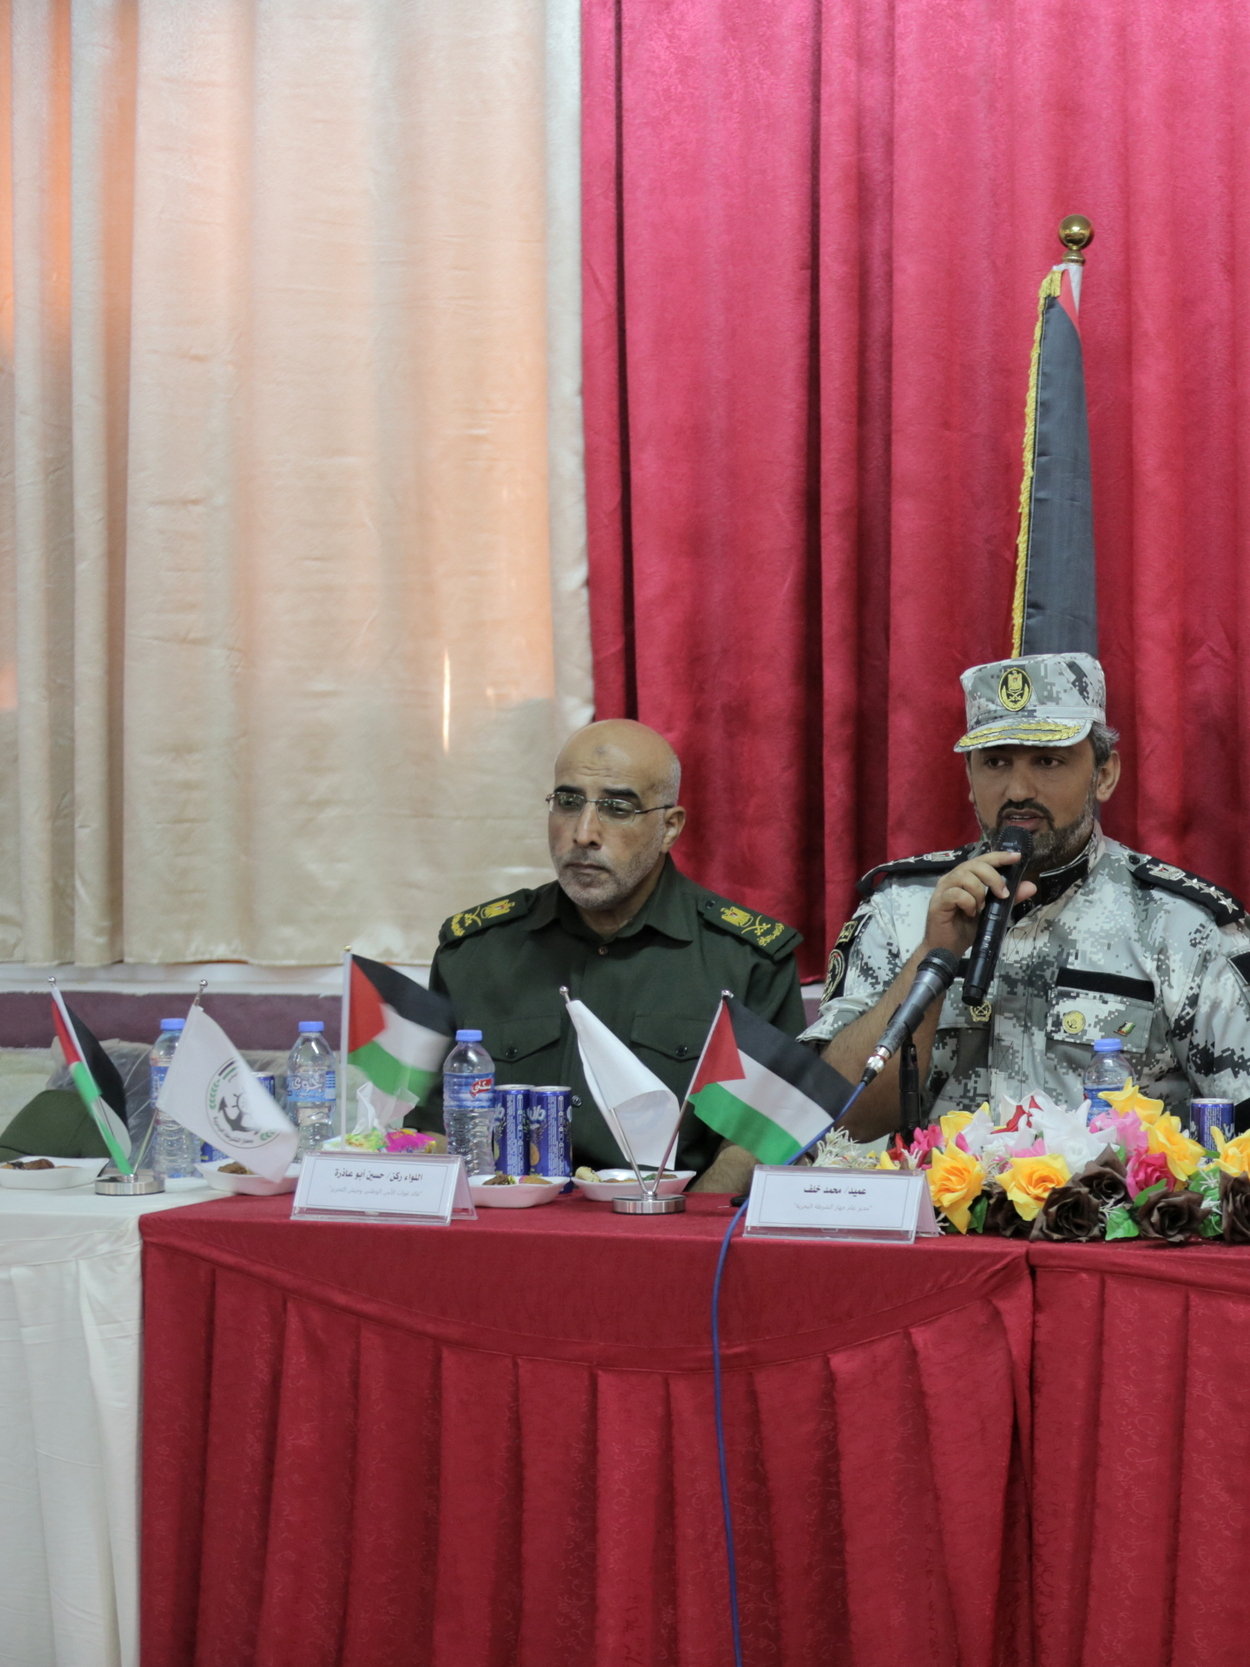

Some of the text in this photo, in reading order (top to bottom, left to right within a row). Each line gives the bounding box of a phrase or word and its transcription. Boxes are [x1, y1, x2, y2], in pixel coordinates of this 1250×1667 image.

[354, 1170, 366, 1181] أبو
[366, 1171, 385, 1182] حسين
[404, 1173, 423, 1182] اللواء
[804, 1184, 821, 1193] خلف
